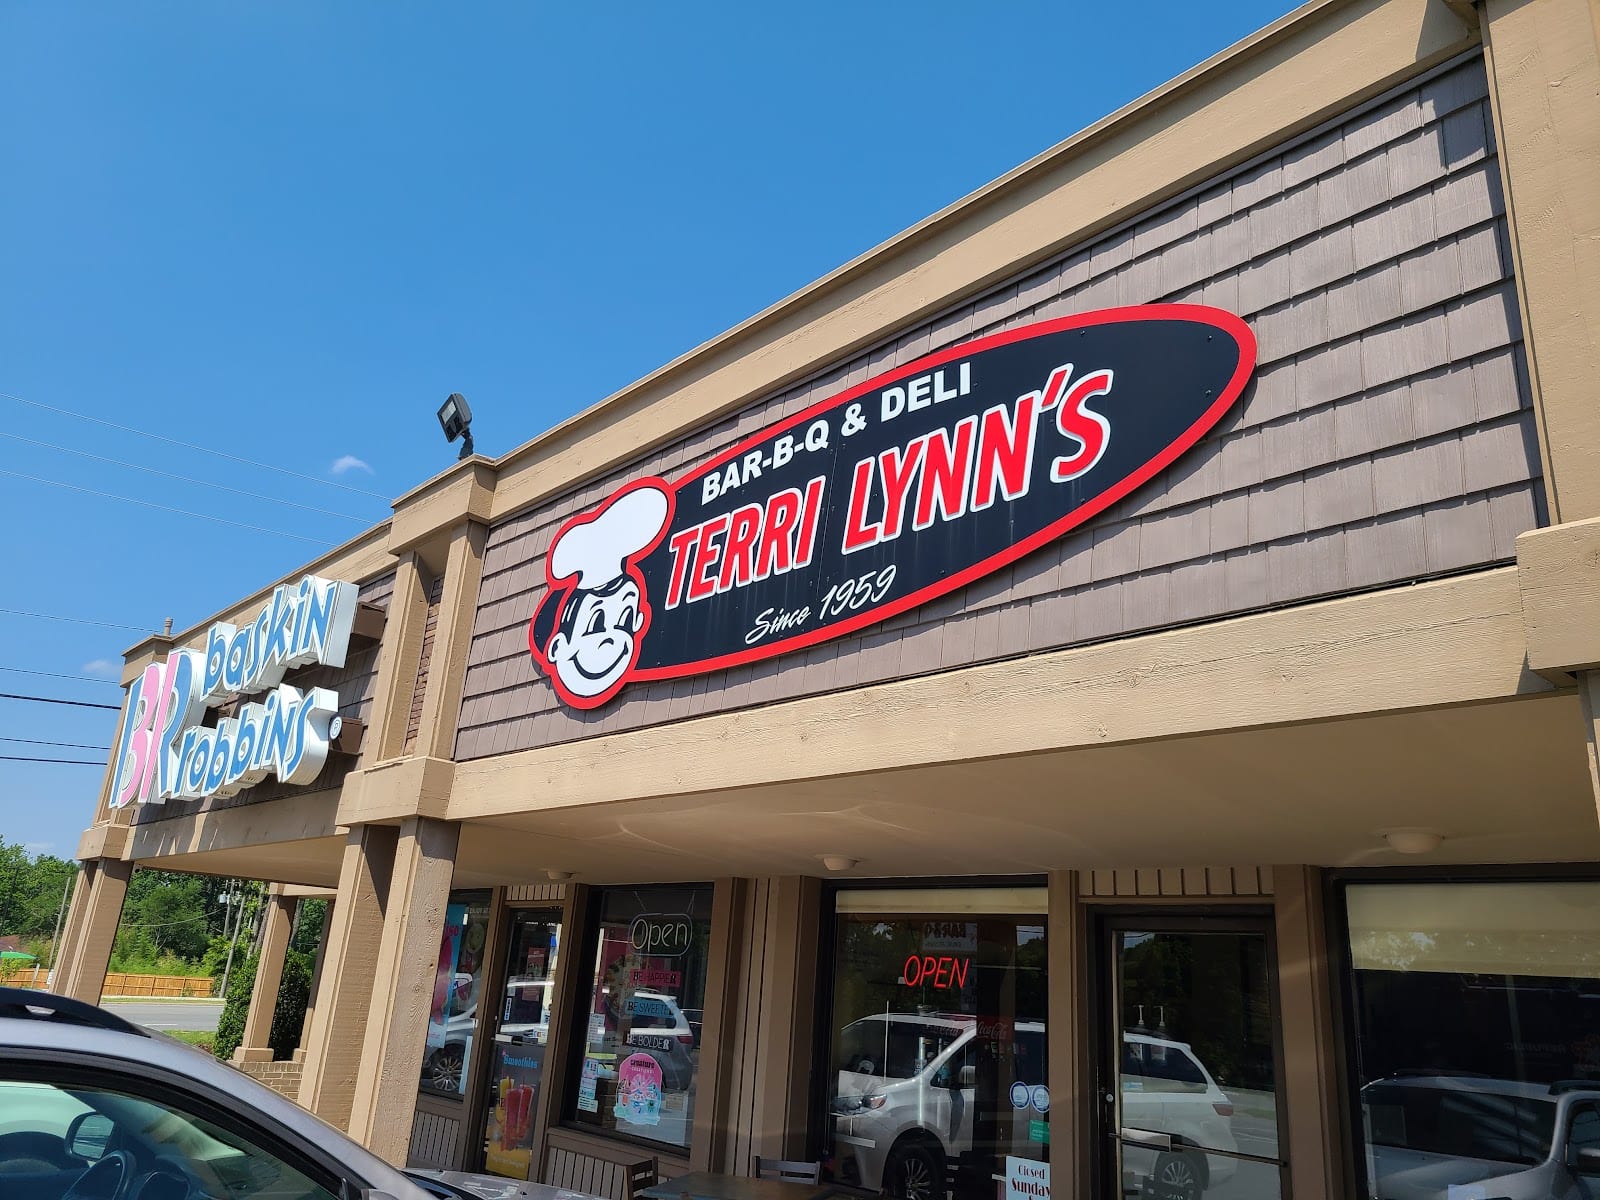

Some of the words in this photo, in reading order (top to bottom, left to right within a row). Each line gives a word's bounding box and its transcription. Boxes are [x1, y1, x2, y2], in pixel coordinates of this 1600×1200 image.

[701, 416, 830, 505] BAR-B-Q
[840, 402, 868, 437] &
[880, 361, 972, 423] DELI
[664, 474, 827, 611] TERRI
[841, 362, 1114, 556] LYNN'S
[744, 603, 812, 645] Since
[818, 565, 898, 622] 1959
[631, 918, 689, 953] Open
[903, 954, 970, 990] OPEN
[1018, 1164, 1045, 1180] Closed
